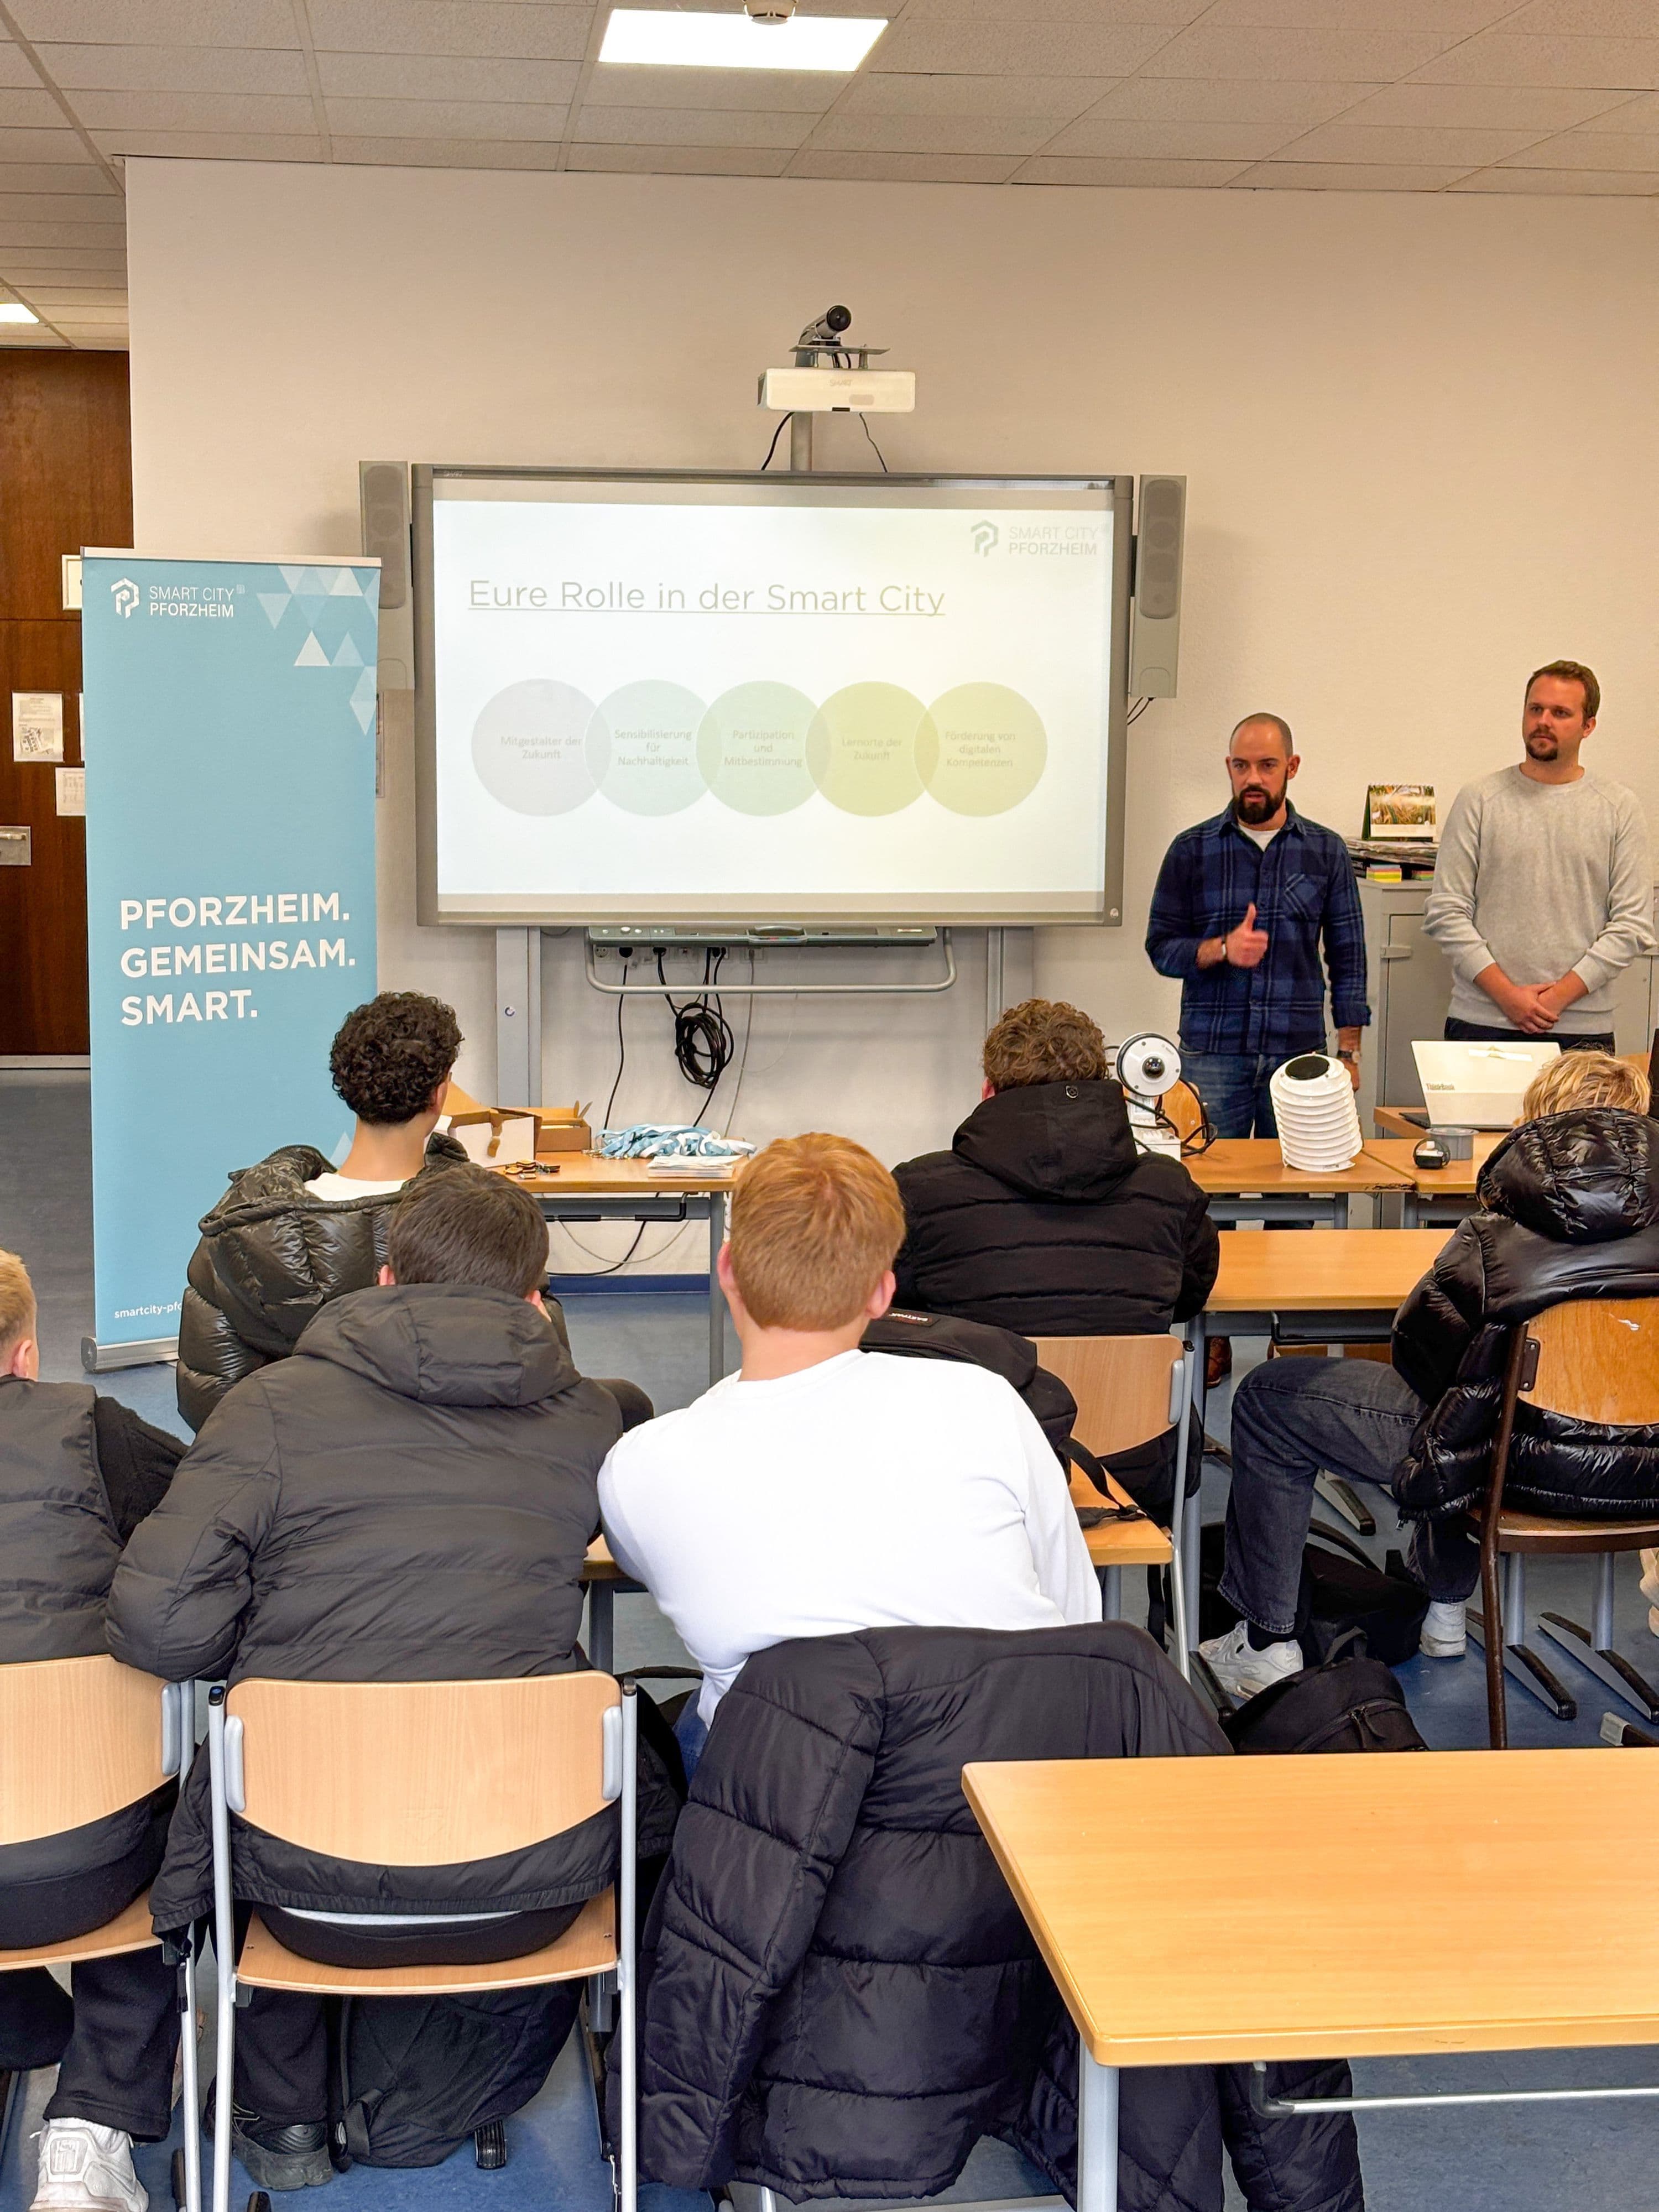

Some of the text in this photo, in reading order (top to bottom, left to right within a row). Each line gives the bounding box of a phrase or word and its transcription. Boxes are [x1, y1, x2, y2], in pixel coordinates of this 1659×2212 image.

[1009, 526, 1098, 540] SMART CITY
[1009, 542, 1097, 555] PFORZHEIM
[149, 586, 199, 601] SMART
[202, 587, 234, 602] CITY
[471, 580, 945, 617] Eure Rolle in der Smart City
[150, 602, 234, 618] PFORZHEIM
[500, 735, 582, 747] Mitgestalter der
[614, 729, 692, 741] Sensibilisierung
[733, 729, 794, 741] Partizipation
[945, 731, 995, 742] Förderung
[646, 742, 660, 753] für
[754, 743, 774, 753] und
[842, 737, 902, 747] Lernorte der
[521, 749, 561, 759] Zukunft
[854, 750, 890, 761] Zukunft
[959, 744, 1000, 755] digitalen
[618, 756, 689, 768] Nachhaltigkeit
[724, 756, 802, 768] Mitbestimmung
[946, 758, 1013, 769] Kompetenzen
[121, 892, 350, 930] PFORZHEIM.
[121, 938, 356, 978] GEMEINSAM.
[121, 989, 258, 1026] SMART.
